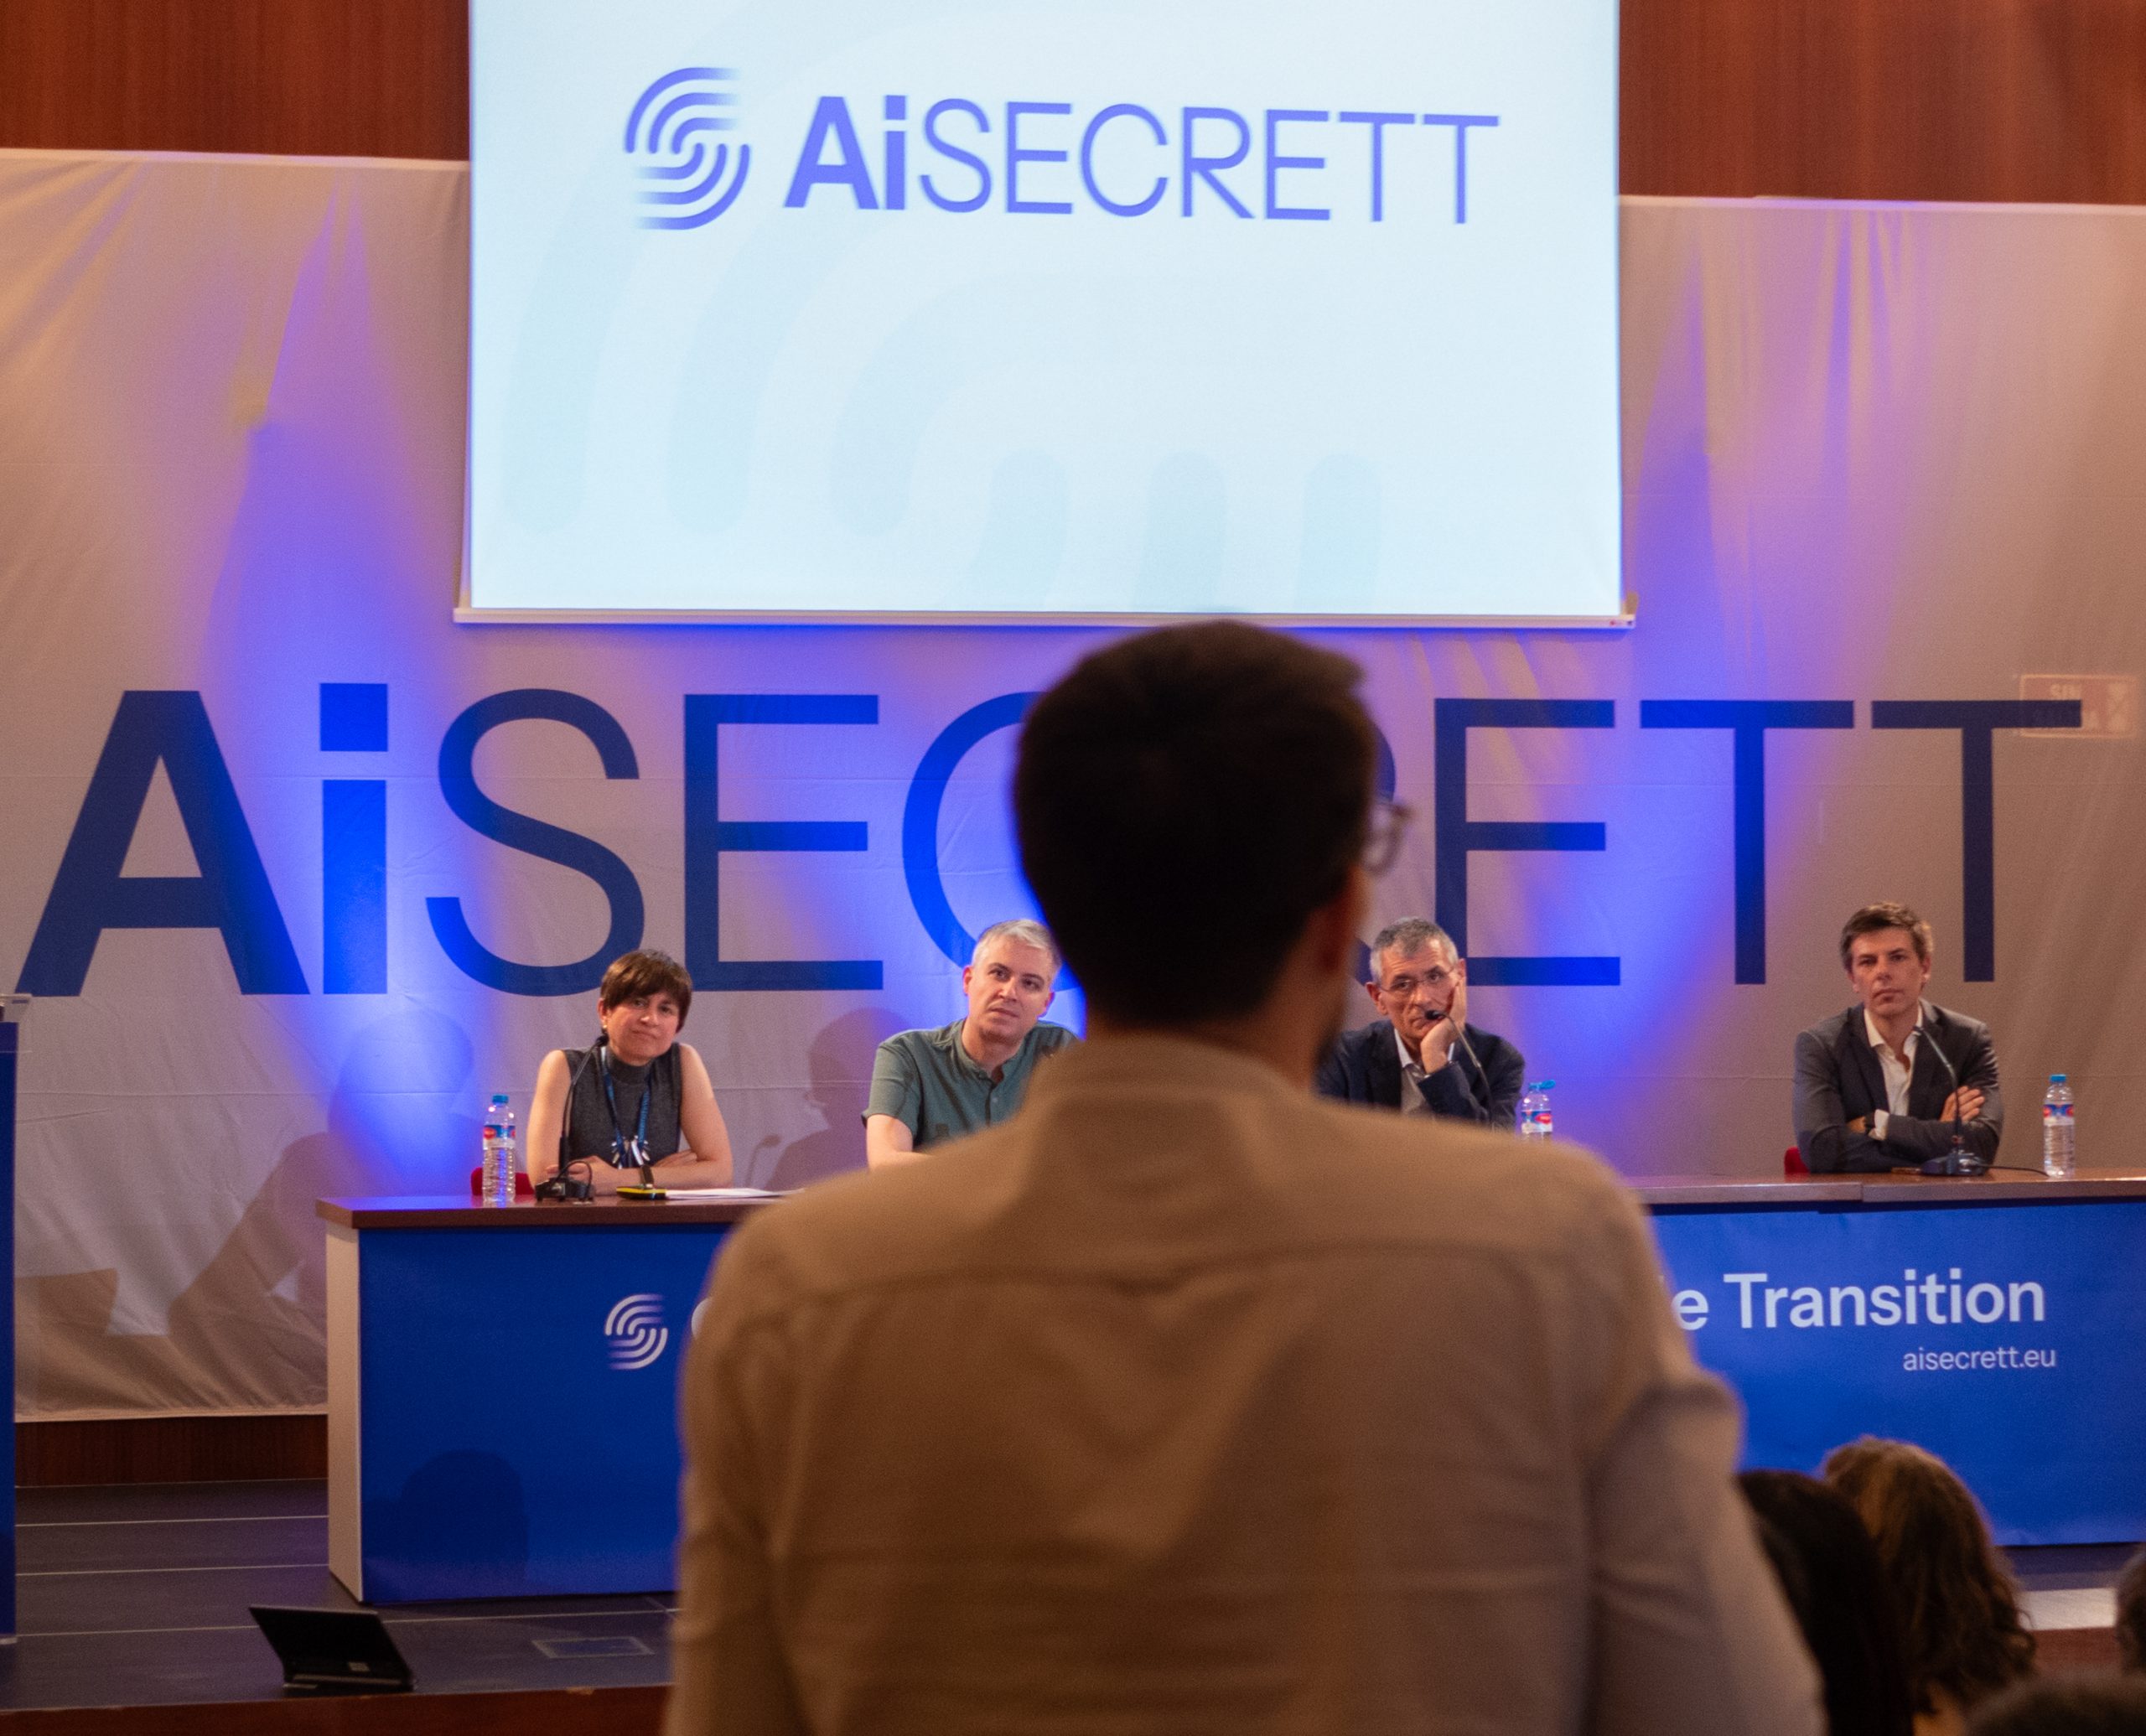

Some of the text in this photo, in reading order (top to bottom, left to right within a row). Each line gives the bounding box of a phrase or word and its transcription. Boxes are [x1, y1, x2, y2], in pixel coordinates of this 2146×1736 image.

[783, 95, 1500, 224] AiSECRETT
[15, 682, 2082, 997] AiSECETT
[1724, 1267, 2045, 1329] Transition
[1903, 1346, 2056, 1371] aisecrett.eu
